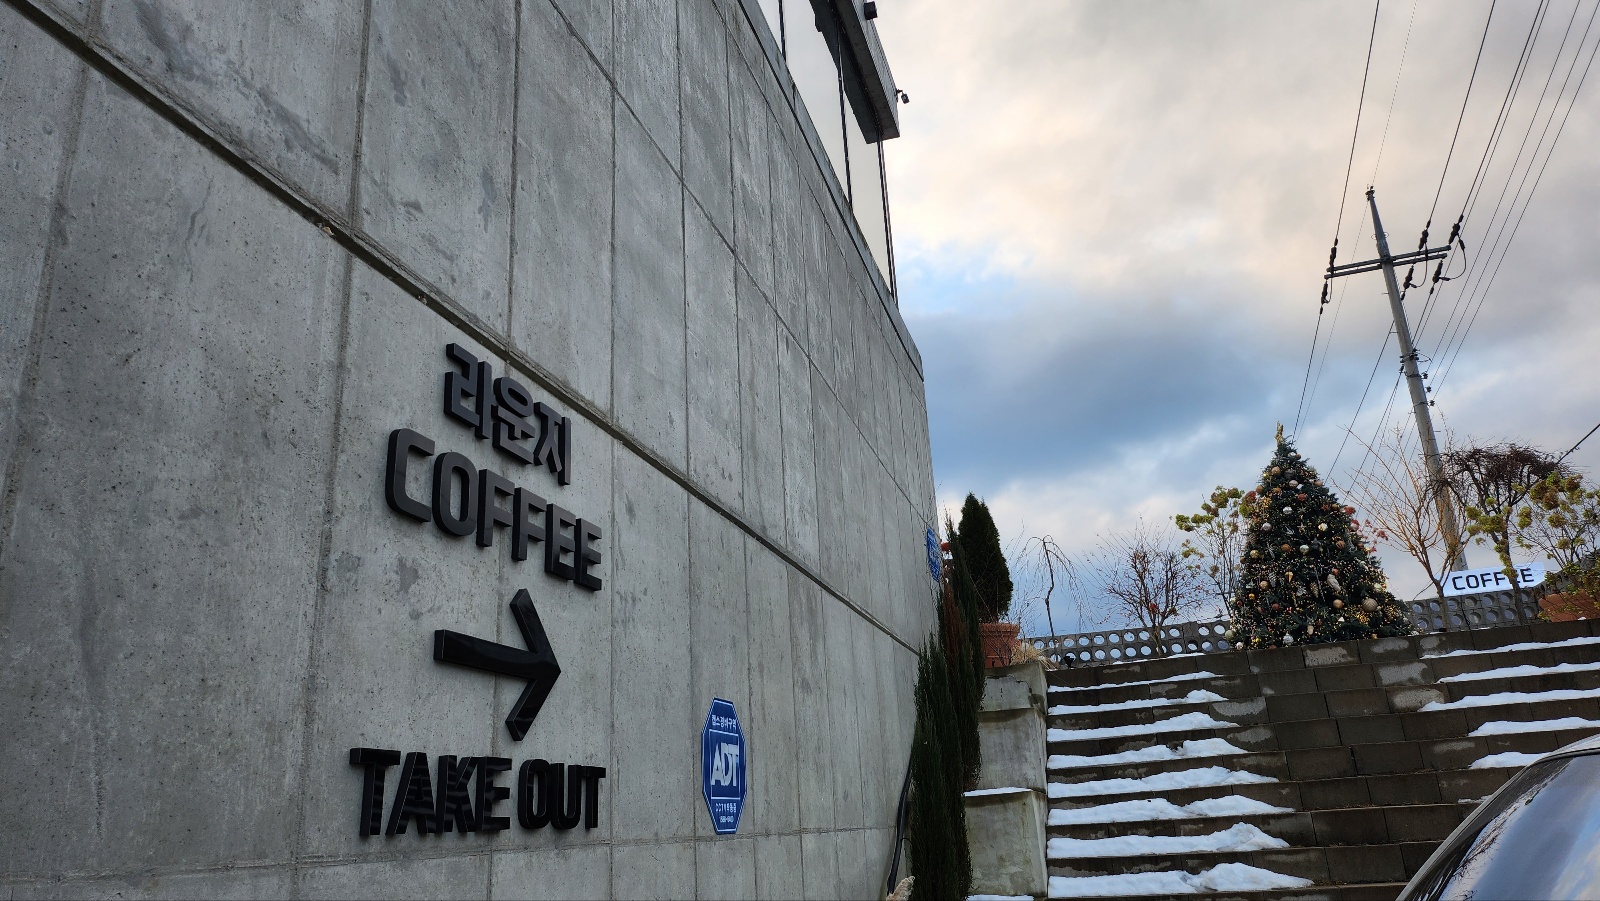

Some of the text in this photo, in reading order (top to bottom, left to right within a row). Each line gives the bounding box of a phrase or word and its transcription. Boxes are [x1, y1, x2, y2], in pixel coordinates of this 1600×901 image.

[444, 343, 571, 485] 라운지
[386, 428, 602, 591] COFFEE
[350, 748, 606, 837] TAKE OUT
[711, 743, 739, 786] ADT
